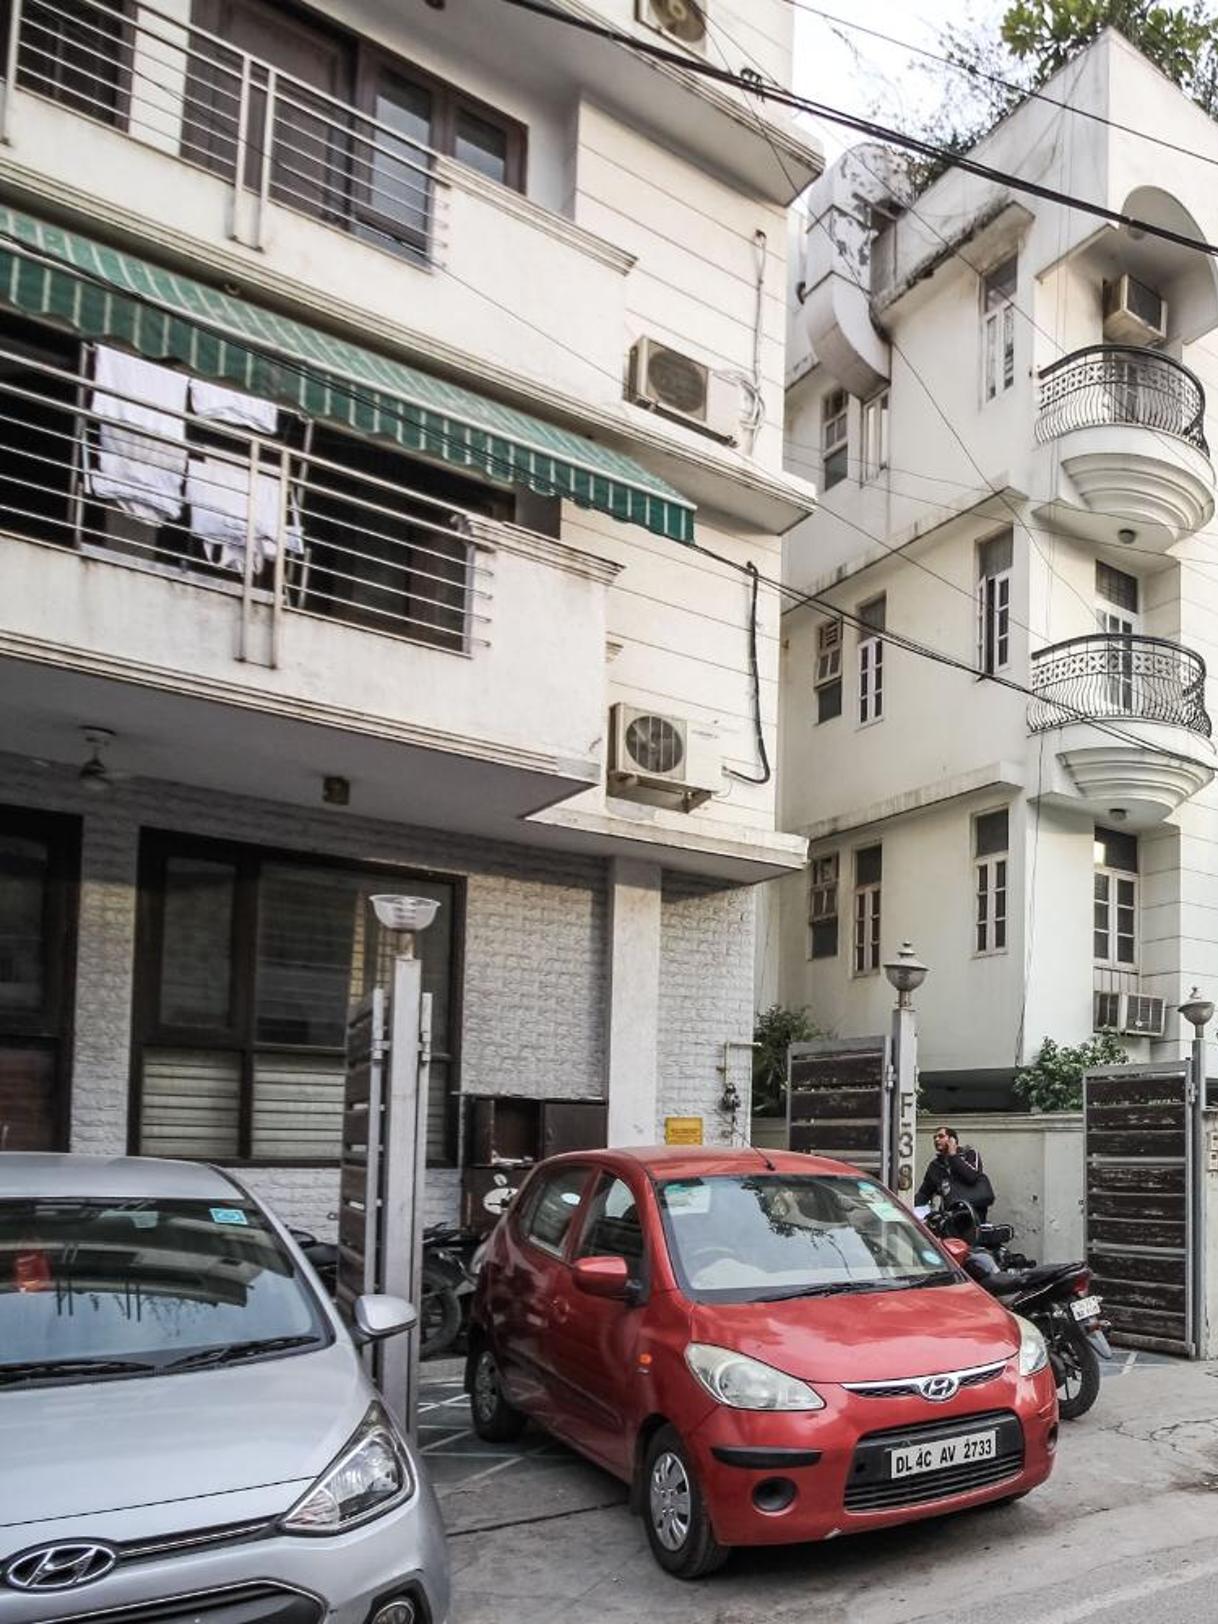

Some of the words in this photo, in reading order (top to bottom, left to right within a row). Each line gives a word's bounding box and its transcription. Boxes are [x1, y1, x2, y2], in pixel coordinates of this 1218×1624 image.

[896, 1455, 912, 1474] DL
[916, 1448, 932, 1468] 4C
[940, 1445, 956, 1464] AV
[964, 1438, 992, 1459] 2733
